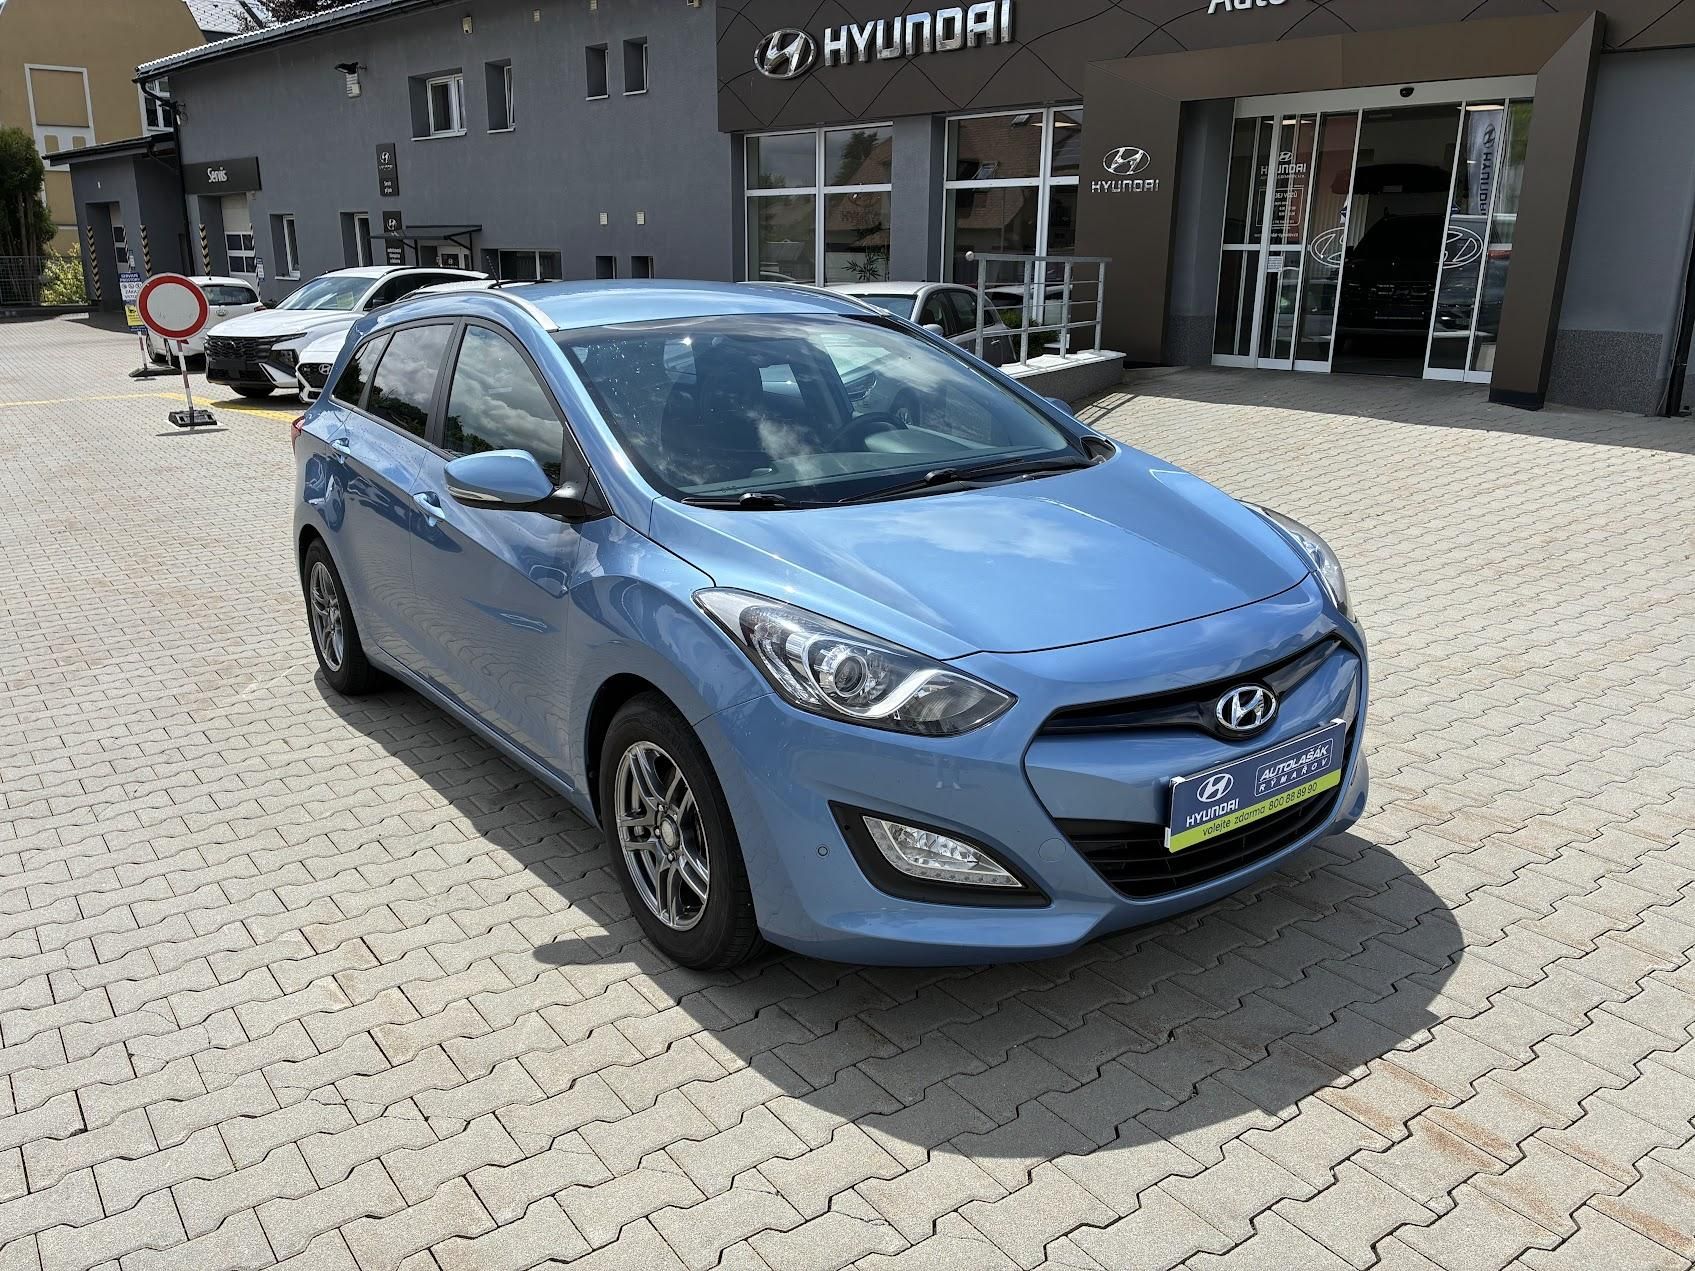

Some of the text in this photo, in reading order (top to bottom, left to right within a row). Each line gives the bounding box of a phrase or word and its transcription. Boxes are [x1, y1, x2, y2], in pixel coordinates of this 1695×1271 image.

[1207, 0, 1286, 14] Au
[824, 0, 1014, 67] HYUNDAI
[207, 166, 228, 183] Servis
[1260, 163, 1307, 175] HUNDAI
[1091, 179, 1159, 193] HYUNDAI
[1259, 744, 1329, 782] AUTOLAŠÁK
[1186, 798, 1239, 828] HYUNDAI
[1202, 781, 1318, 836] volejte zdarma 800 88 89 90
